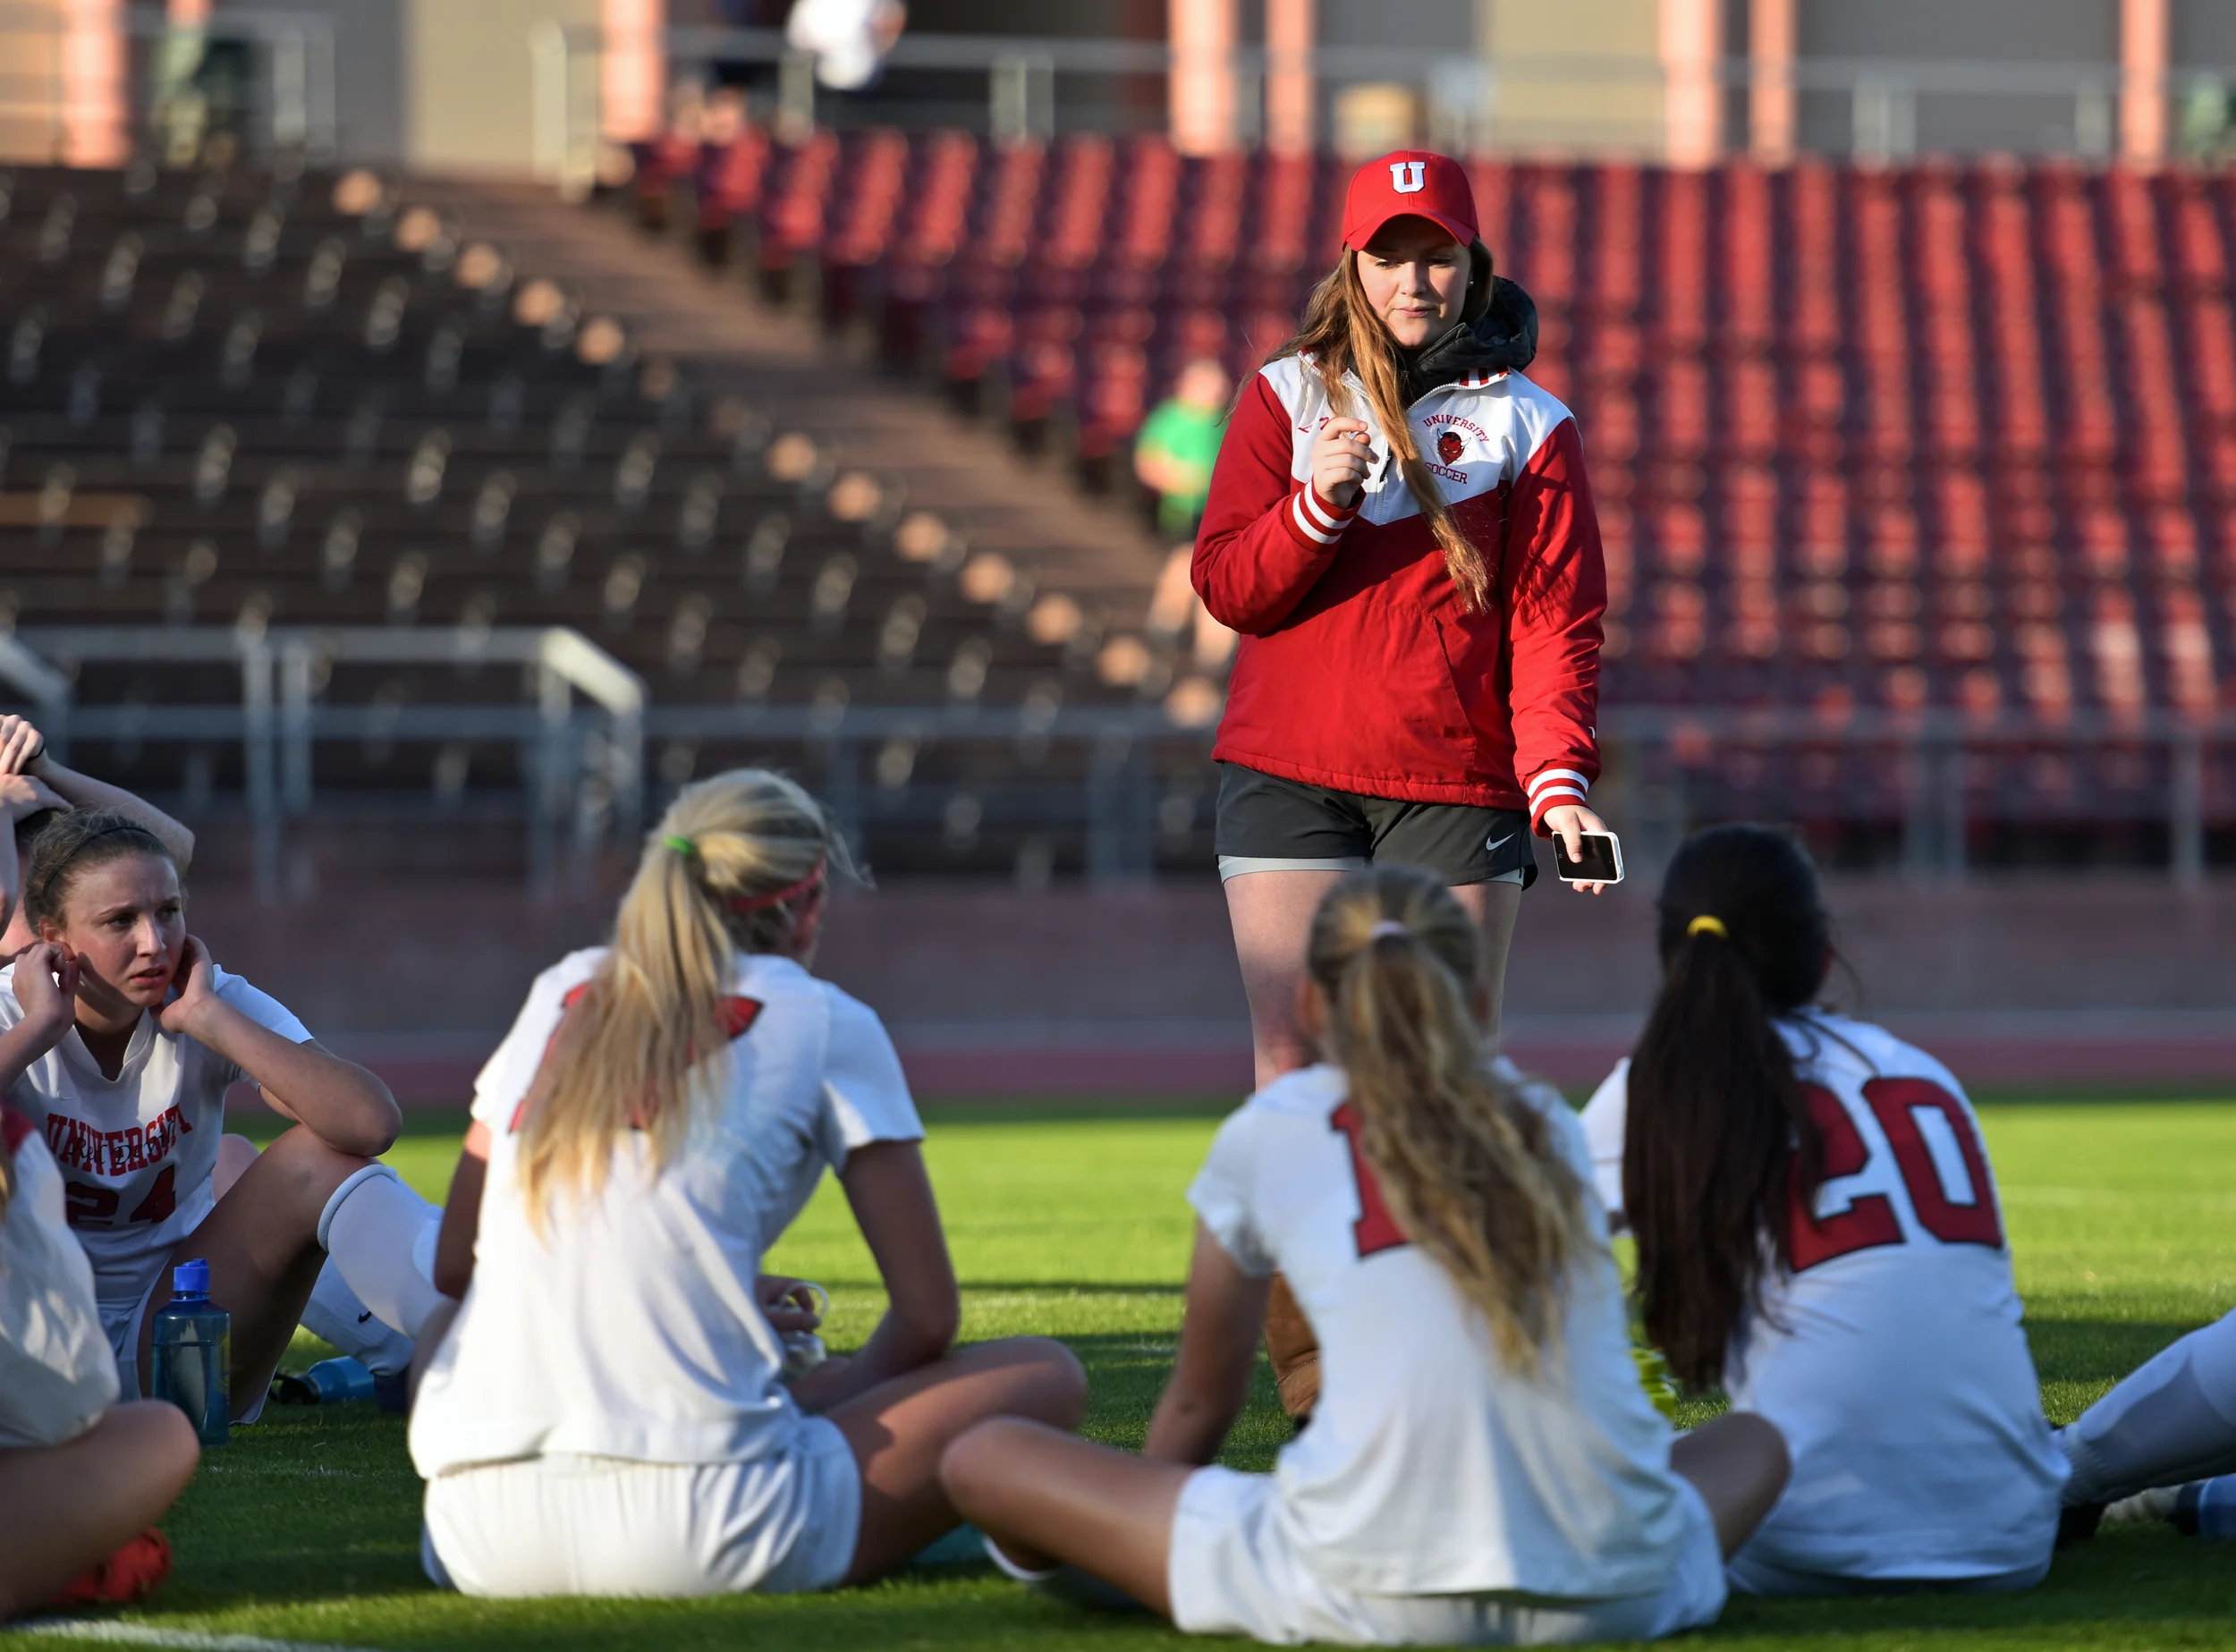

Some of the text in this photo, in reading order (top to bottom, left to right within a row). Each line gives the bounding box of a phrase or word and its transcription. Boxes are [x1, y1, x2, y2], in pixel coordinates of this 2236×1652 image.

[1389, 161, 1426, 194] U
[1423, 414, 1490, 443] UNIVERSITY
[1424, 462, 1468, 485] SOCCER
[1788, 1076, 2004, 1275] 20
[65, 1163, 176, 1226] 24
